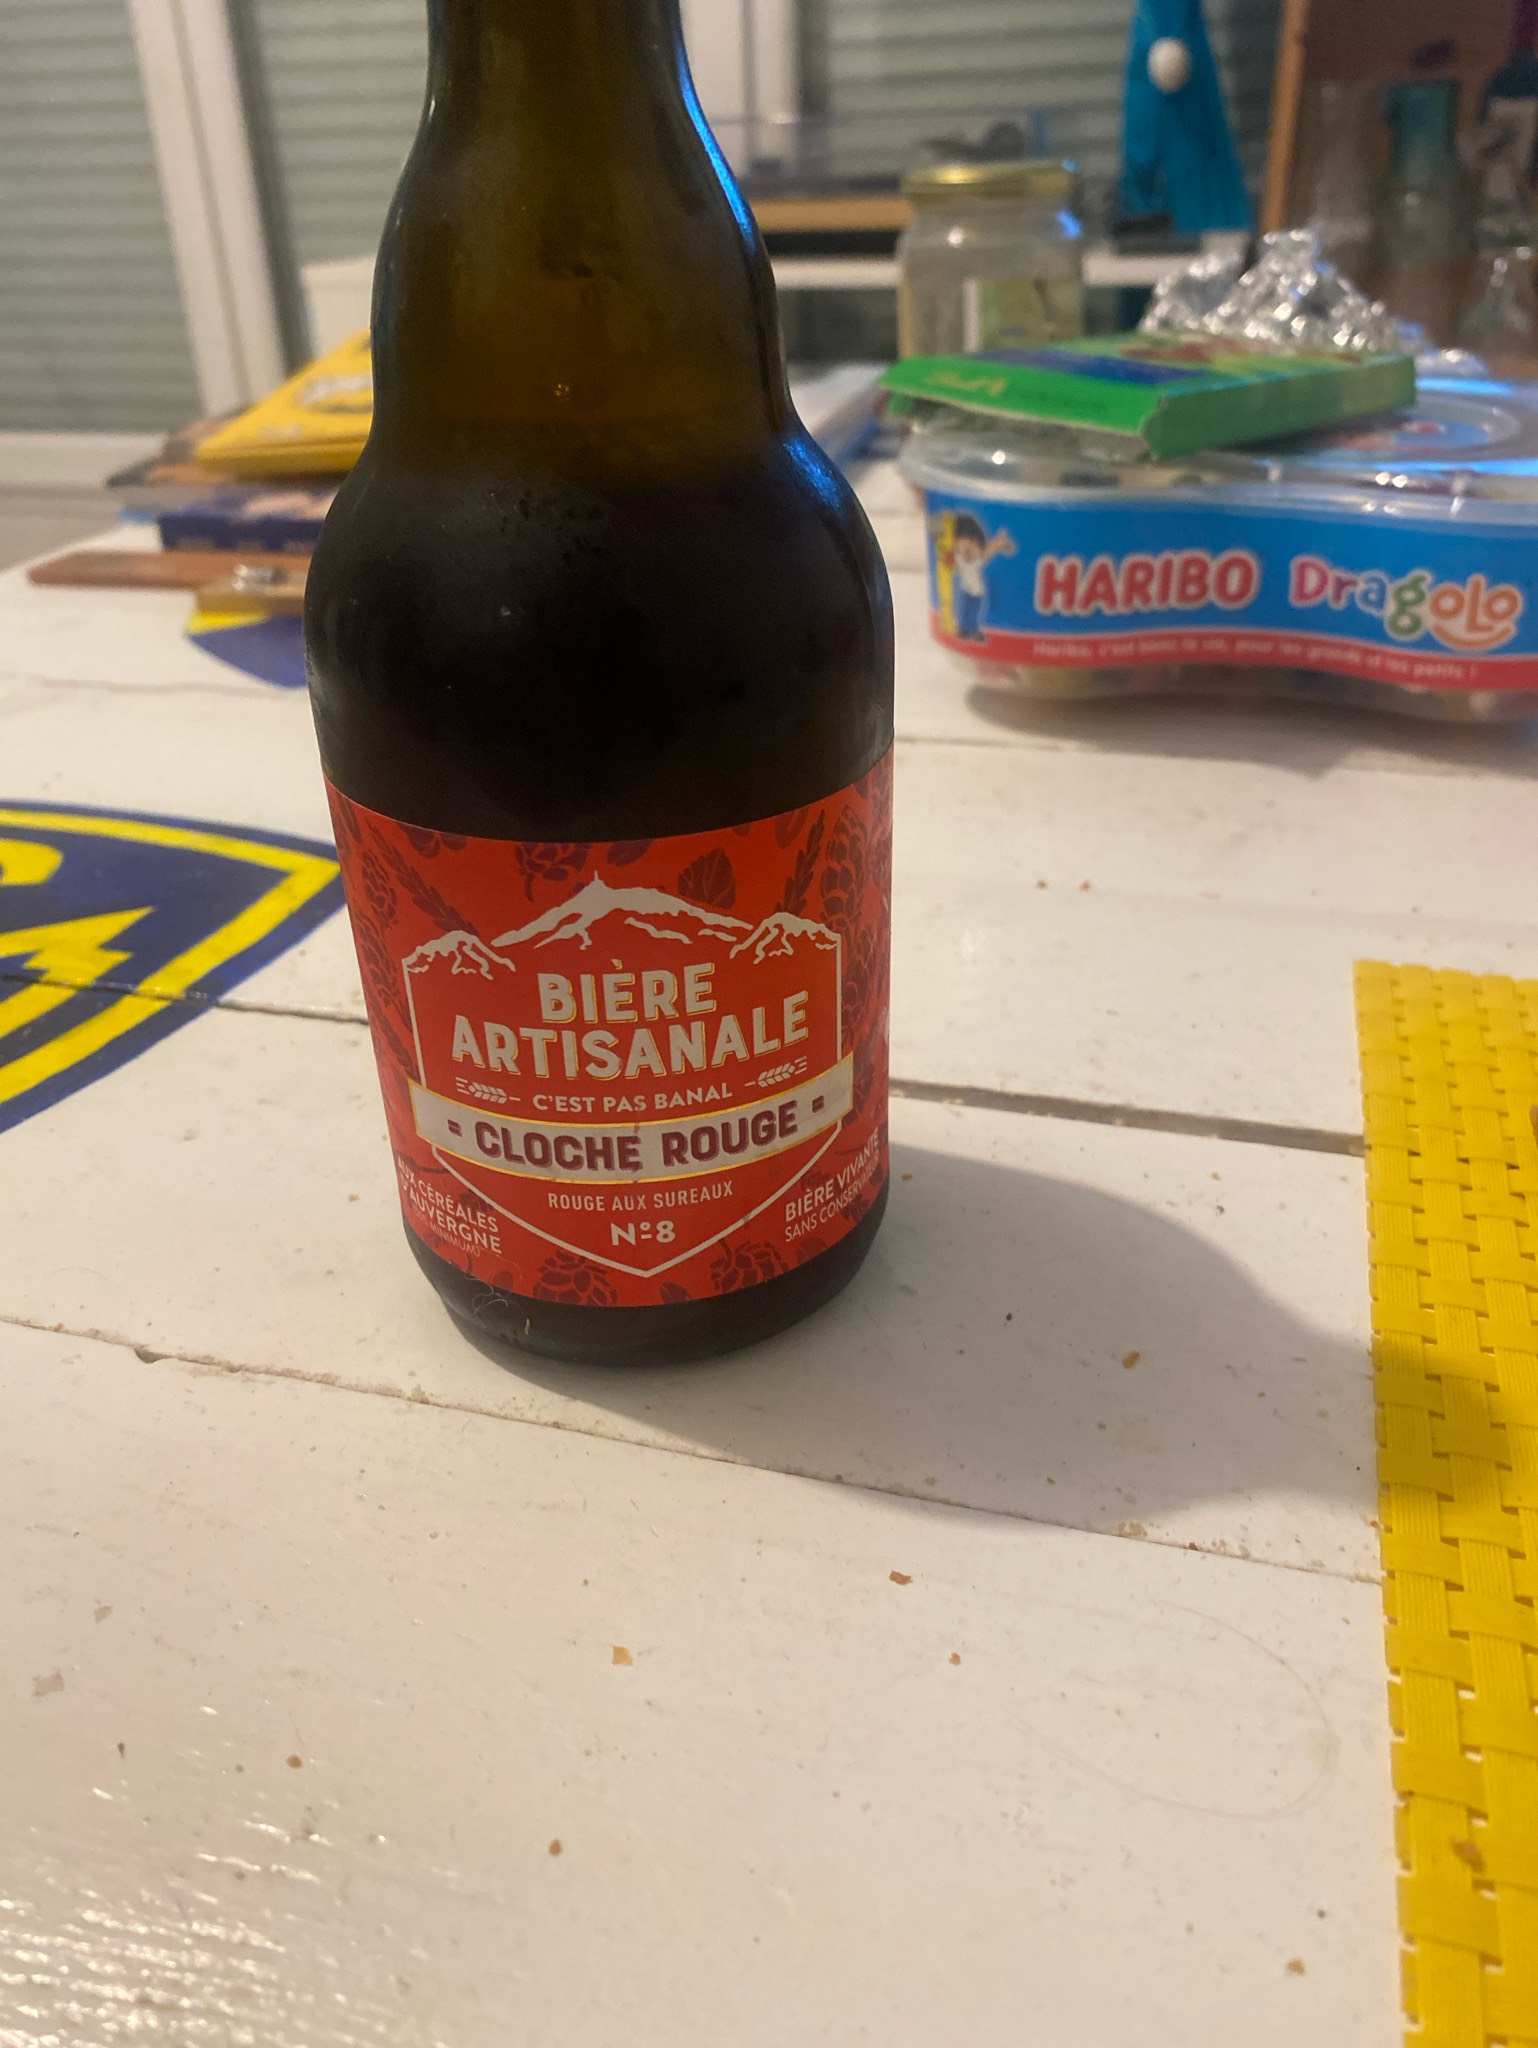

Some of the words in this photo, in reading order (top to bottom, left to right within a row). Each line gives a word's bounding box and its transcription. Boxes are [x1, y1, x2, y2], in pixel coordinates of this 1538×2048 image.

[1035, 552, 1258, 612] HARIBO
[537, 958, 717, 1024] BIÈRE
[451, 990, 809, 1080] ARTISANALE
[532, 1093, 595, 1113] C'EST
[603, 1094, 648, 1113] PAS
[654, 1082, 733, 1111] BANAL
[474, 1121, 644, 1172] CLOCHE
[661, 1100, 799, 1168] ROUGE
[547, 1192, 605, 1212] ROUGE
[611, 1194, 648, 1212] AUX
[652, 1180, 734, 1210] SUREAUX
[785, 1177, 835, 1223] BIÈRE
[836, 1126, 880, 1190] VIVANTE
[418, 1179, 499, 1233] CÉRÉALES
[784, 1213, 818, 1243] SANS
